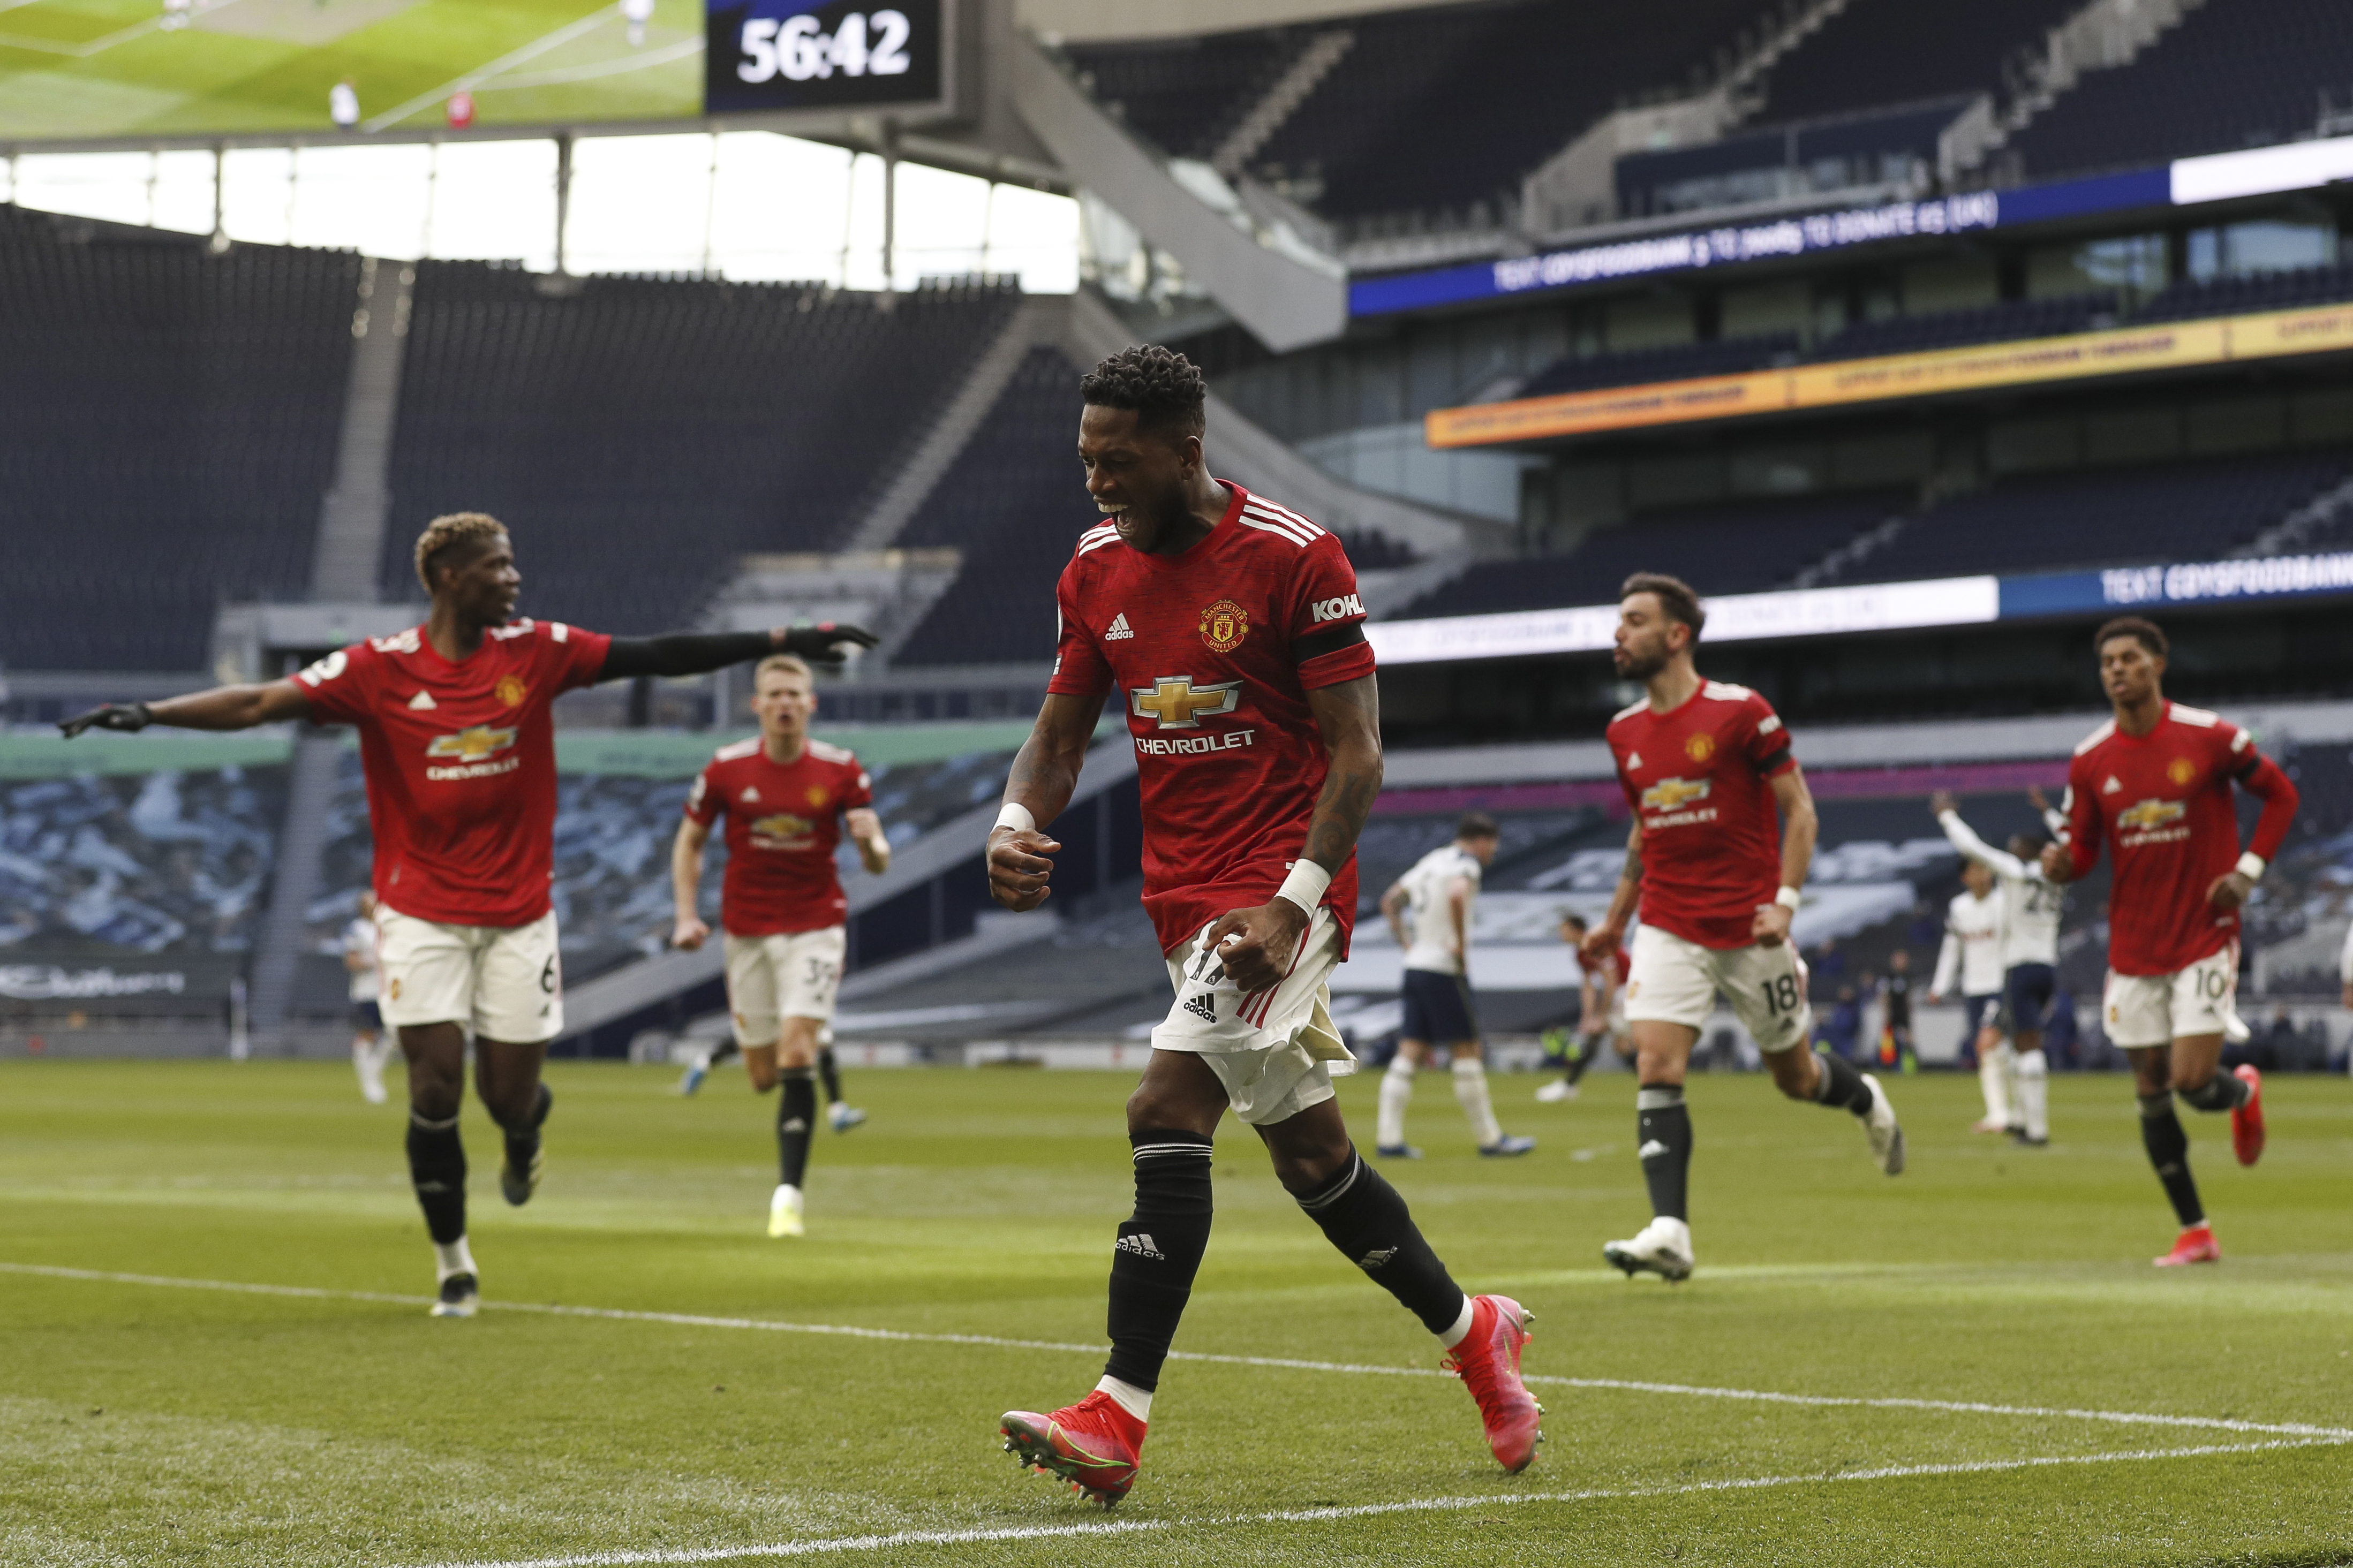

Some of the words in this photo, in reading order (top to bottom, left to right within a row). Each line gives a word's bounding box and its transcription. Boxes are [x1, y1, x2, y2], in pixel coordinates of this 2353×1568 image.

[736, 9, 910, 84] 56:42
[2101, 565, 2164, 604] TEXT
[1205, 603, 1244, 621] MANCHESTER
[1312, 594, 1366, 623] KOHL
[1105, 630, 1134, 641] adidas
[1209, 640, 1237, 649] UNITED
[1135, 730, 1255, 755] CHEVROLET
[426, 756, 519, 781] CHEVROLET
[540, 953, 556, 994] 6
[2196, 967, 2226, 999] 10
[1761, 973, 1798, 1016] 18
[1183, 1001, 1218, 1024] adidas
[1115, 1242, 1165, 1260] adidas
